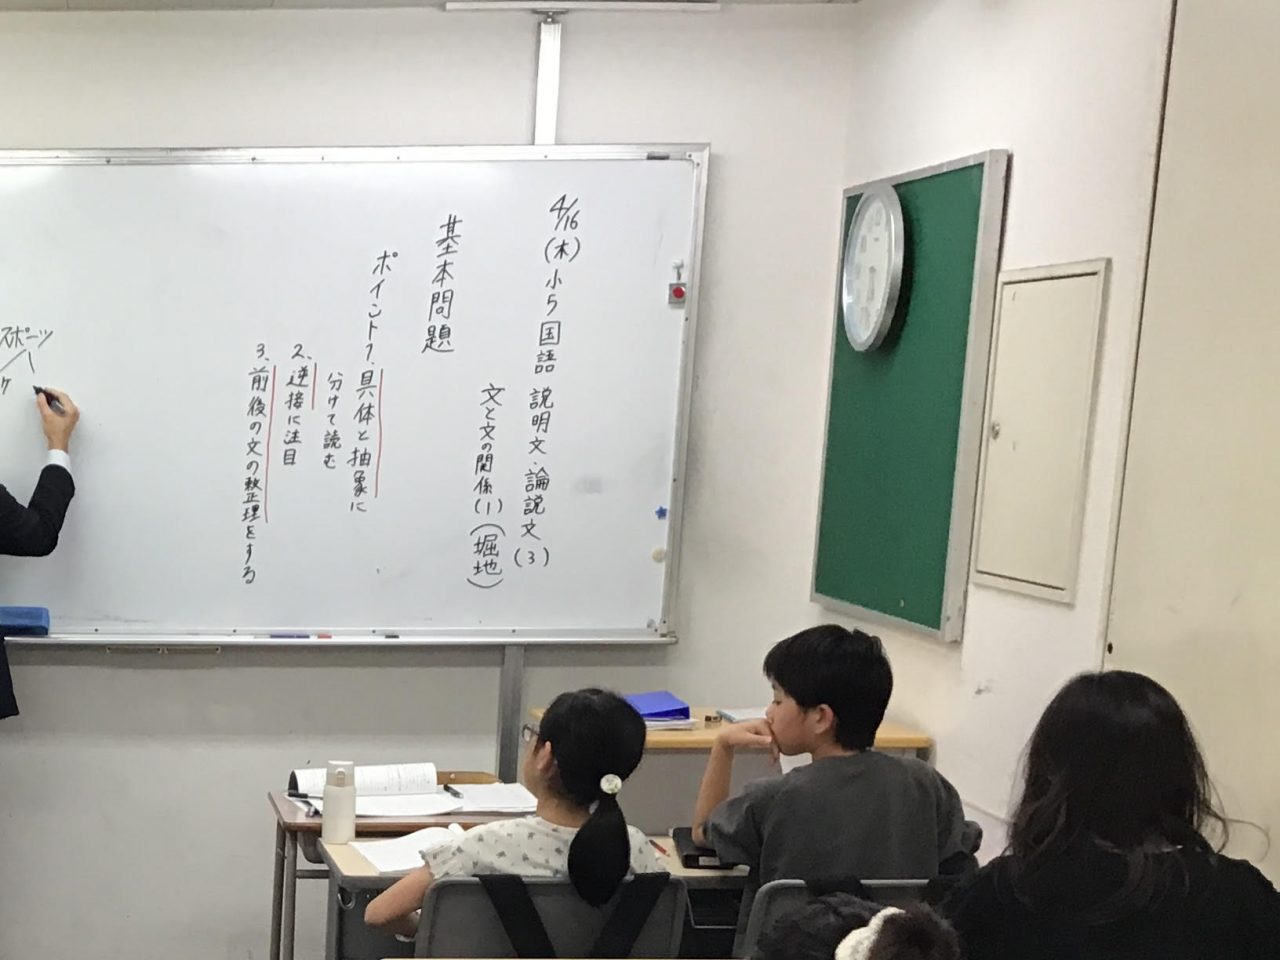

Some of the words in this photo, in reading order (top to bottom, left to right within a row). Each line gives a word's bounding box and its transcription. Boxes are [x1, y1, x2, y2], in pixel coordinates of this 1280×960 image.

[421, 213, 463, 354] 基本問題
[322, 371, 344, 470] 分けて読む
